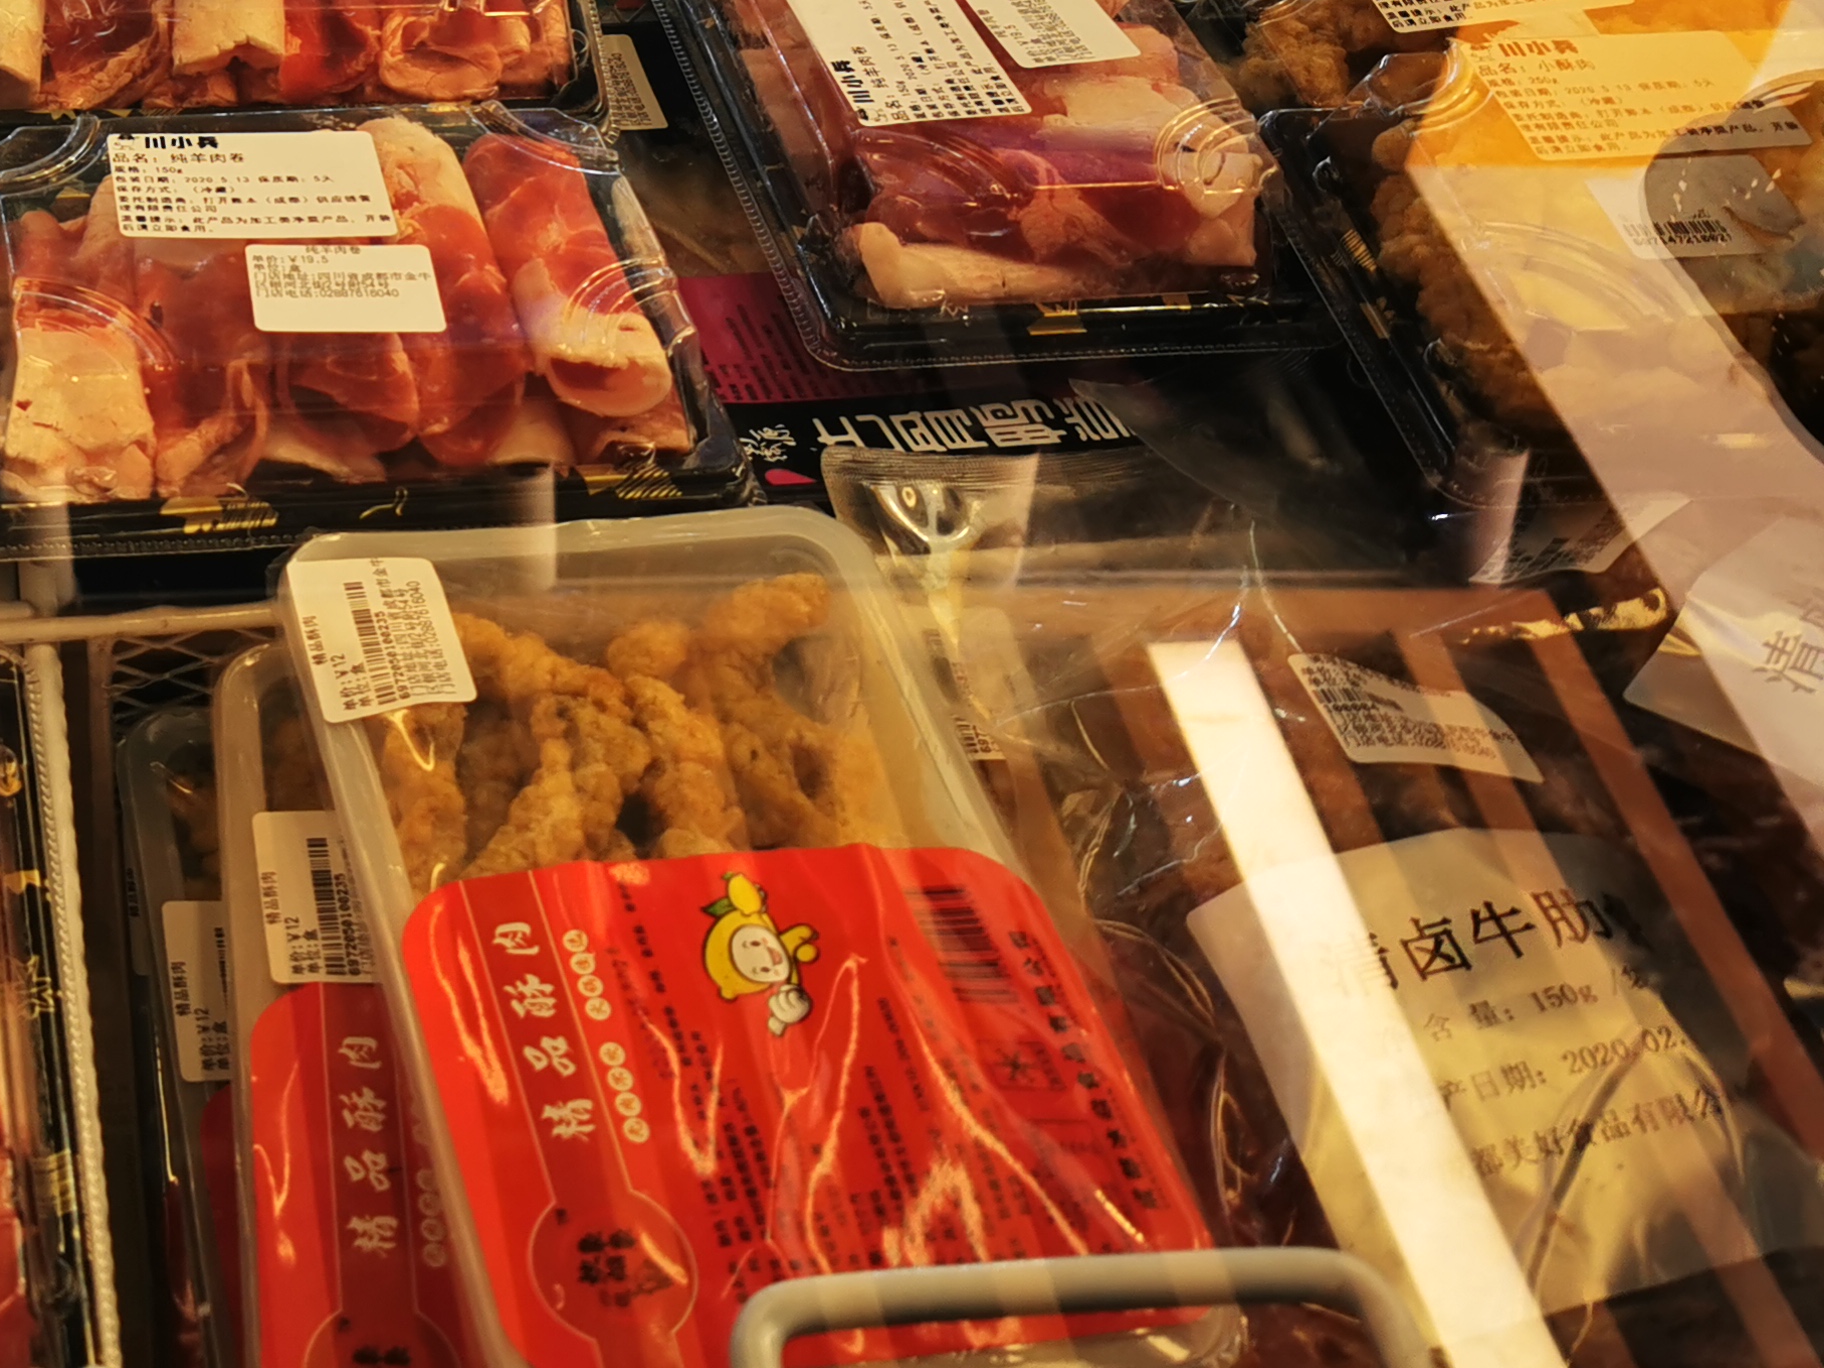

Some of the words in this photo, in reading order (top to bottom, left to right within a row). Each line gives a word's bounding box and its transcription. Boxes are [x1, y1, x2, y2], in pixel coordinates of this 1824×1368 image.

[1498, 39, 1579, 57] 川小兵
[831, 59, 875, 104] 川小兵
[144, 136, 219, 149] 川小兵
[302, 615, 327, 666] 精品酥肉
[260, 871, 280, 924] 精品酥肉
[1321, 889, 1636, 998] 清卤牛肋
[493, 921, 596, 1141] 精品酥肉
[338, 1035, 398, 1257] 精品酥肉
